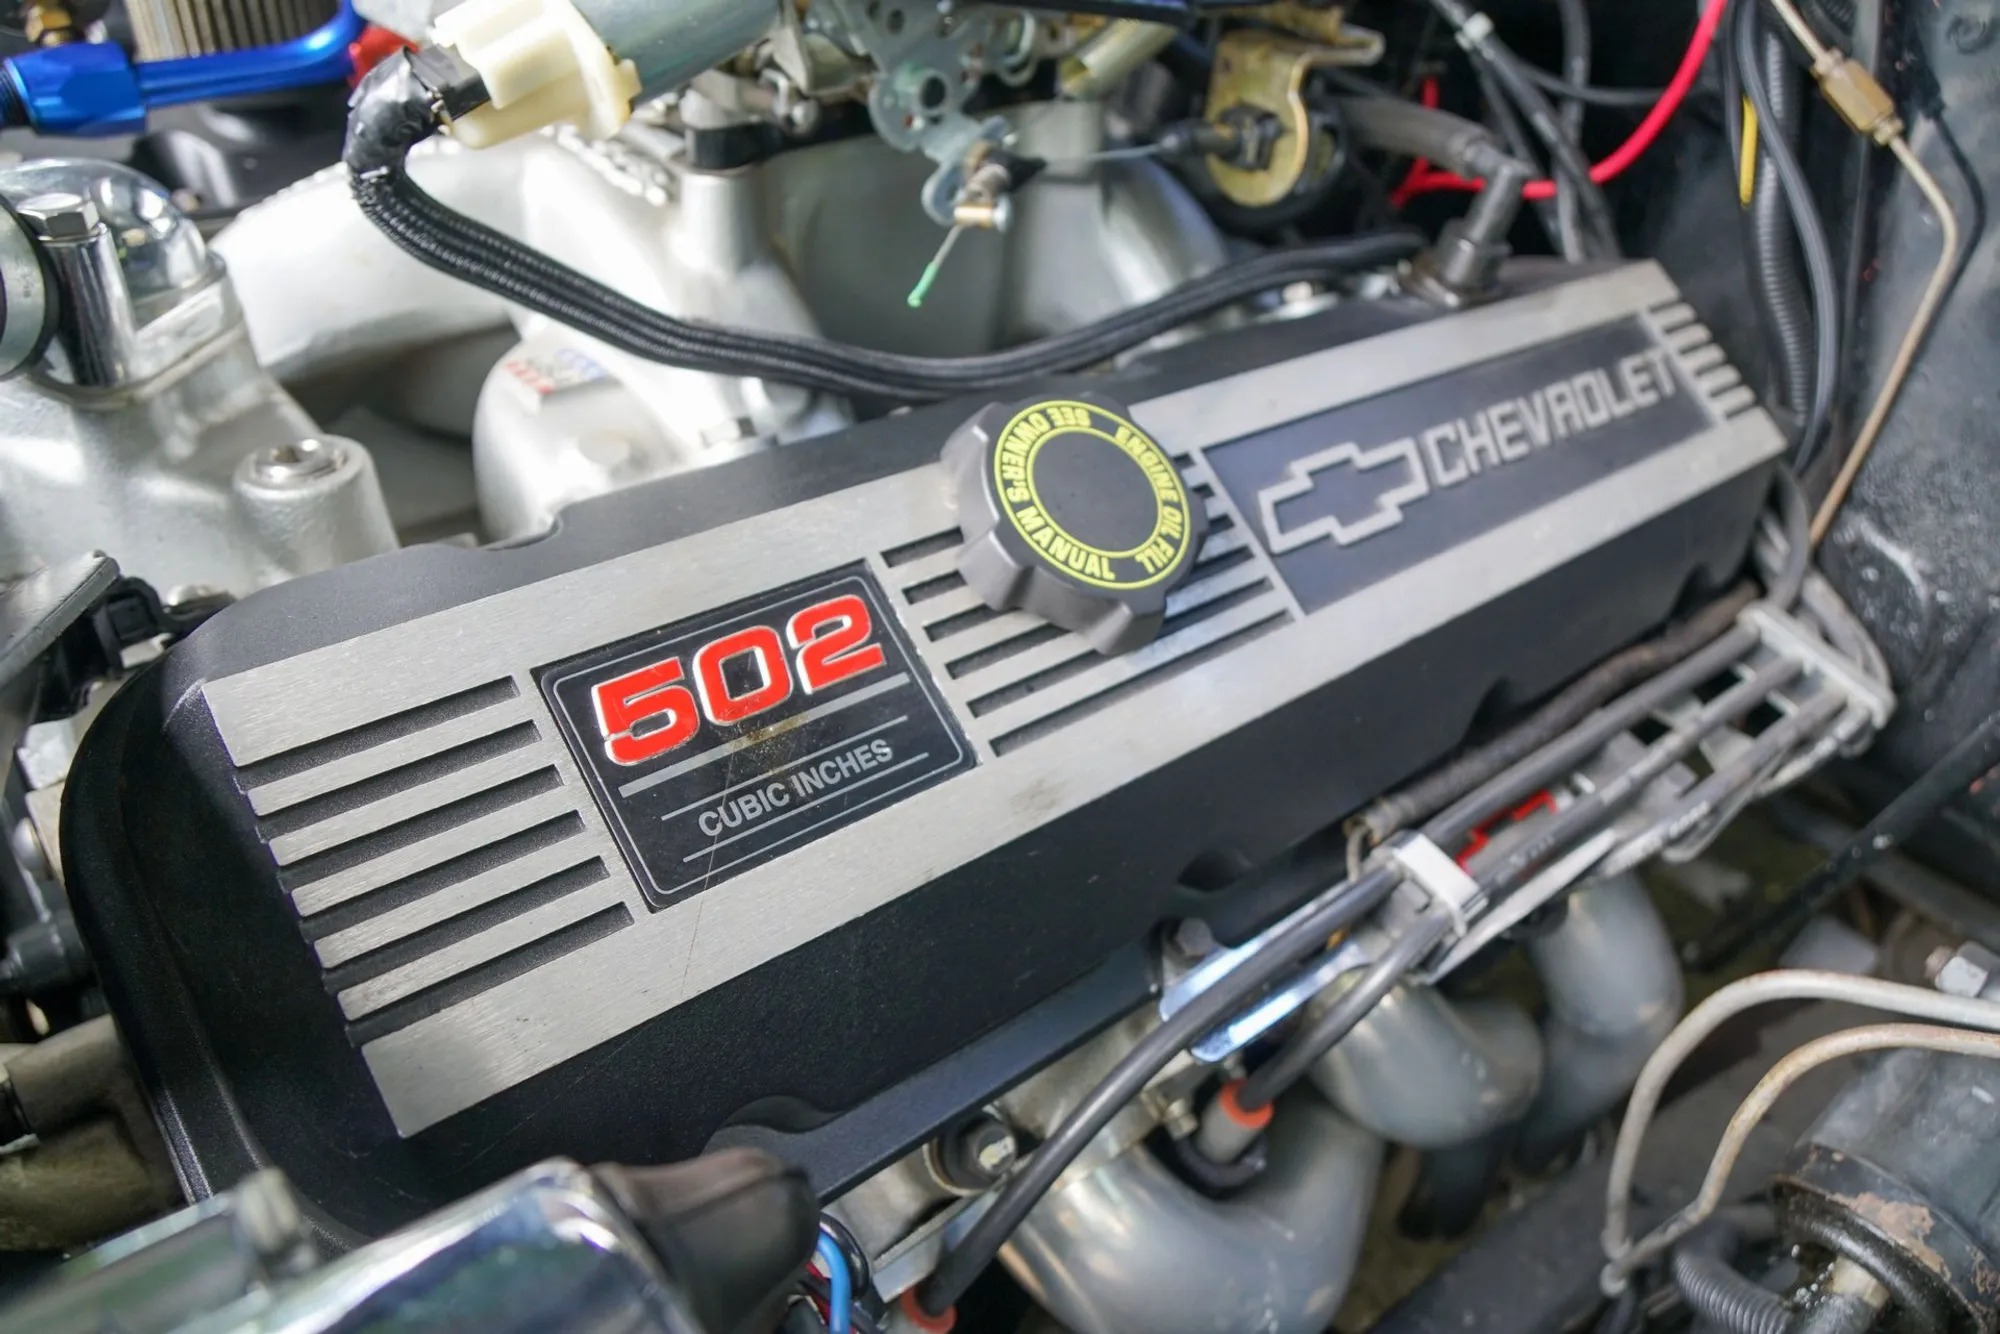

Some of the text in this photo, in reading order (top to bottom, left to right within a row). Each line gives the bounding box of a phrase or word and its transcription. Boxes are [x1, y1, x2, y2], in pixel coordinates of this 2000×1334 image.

[1424, 347, 1677, 487] CHEVROLET
[1001, 406, 1116, 581] SEE OWNER'S MANUAL
[1115, 426, 1184, 574] ENGINE OIL FILL
[591, 594, 887, 767] 502
[698, 738, 895, 838] CUBIC INCHES
